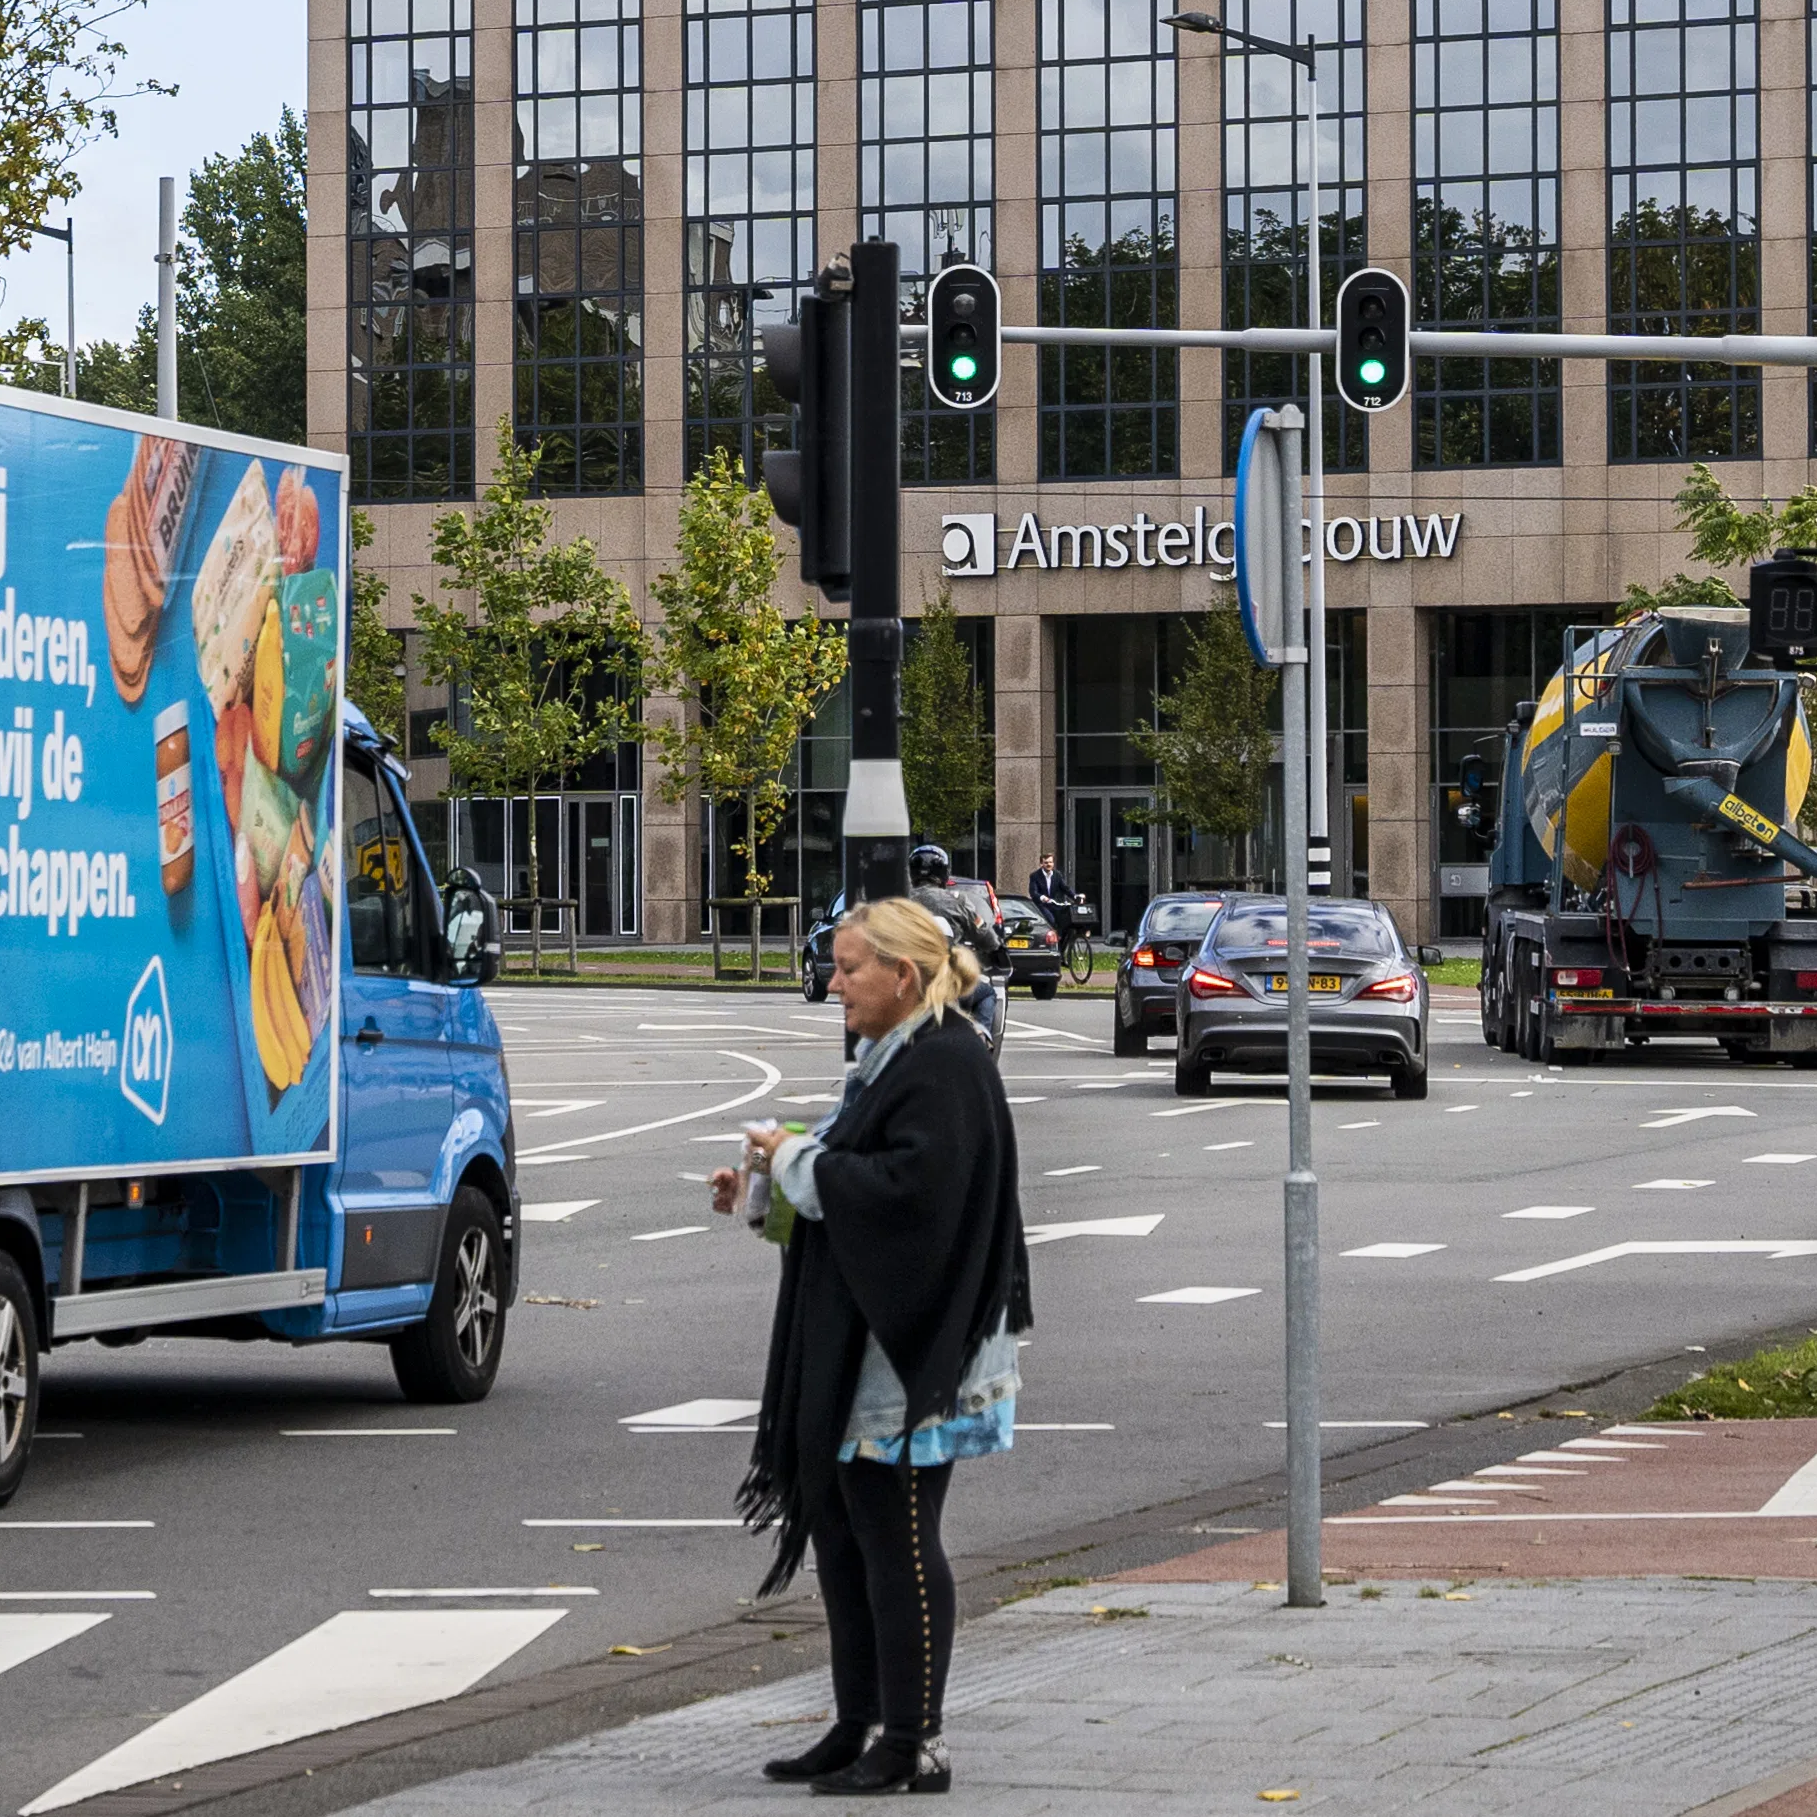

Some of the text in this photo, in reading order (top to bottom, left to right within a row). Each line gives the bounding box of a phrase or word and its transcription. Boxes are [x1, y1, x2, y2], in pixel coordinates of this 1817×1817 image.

[954, 391, 973, 402] 713
[1363, 396, 1382, 407] 712
[41, 709, 84, 803] de
[17, 1041, 42, 1071] van
[43, 1030, 84, 1070] Albert
[84, 1029, 118, 1076] Heijn
